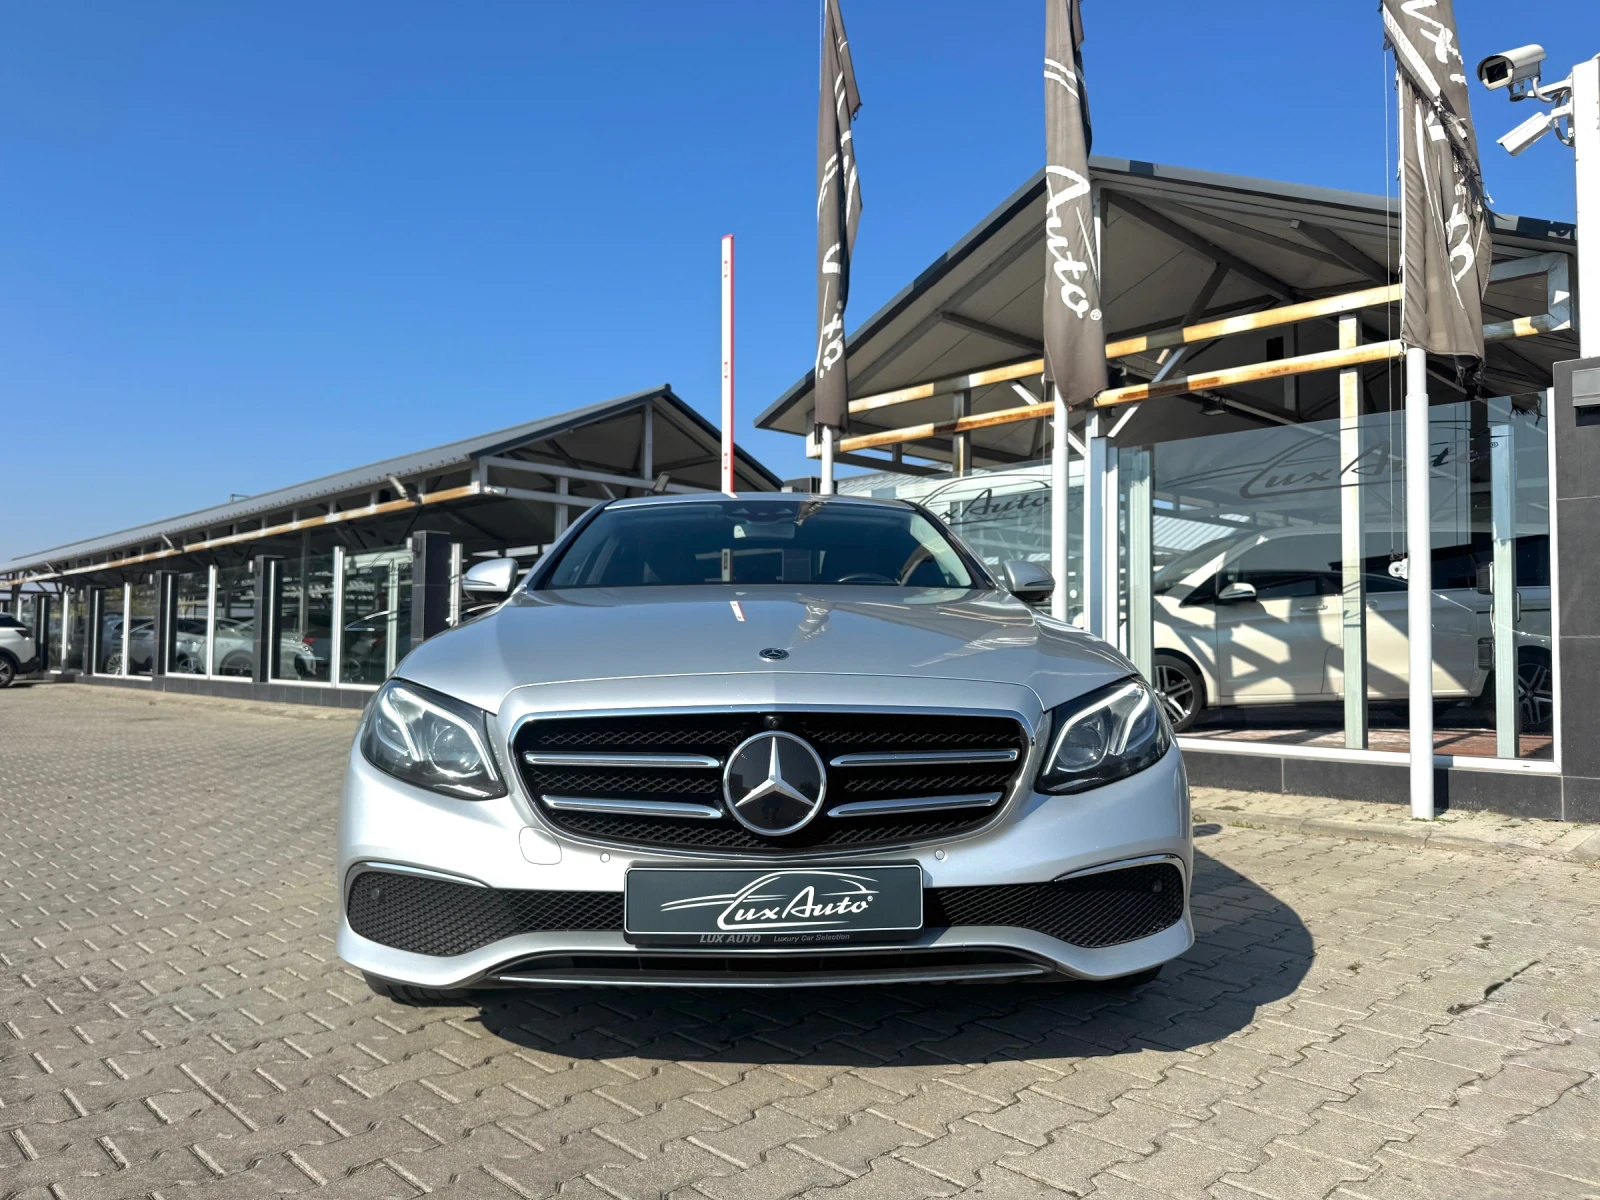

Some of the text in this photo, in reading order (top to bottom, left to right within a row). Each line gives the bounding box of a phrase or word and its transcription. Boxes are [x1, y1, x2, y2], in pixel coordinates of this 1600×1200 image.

[960, 488, 1049, 518] Auto
[699, 933, 851, 944] LUX AUTO Luxury Car Selection
